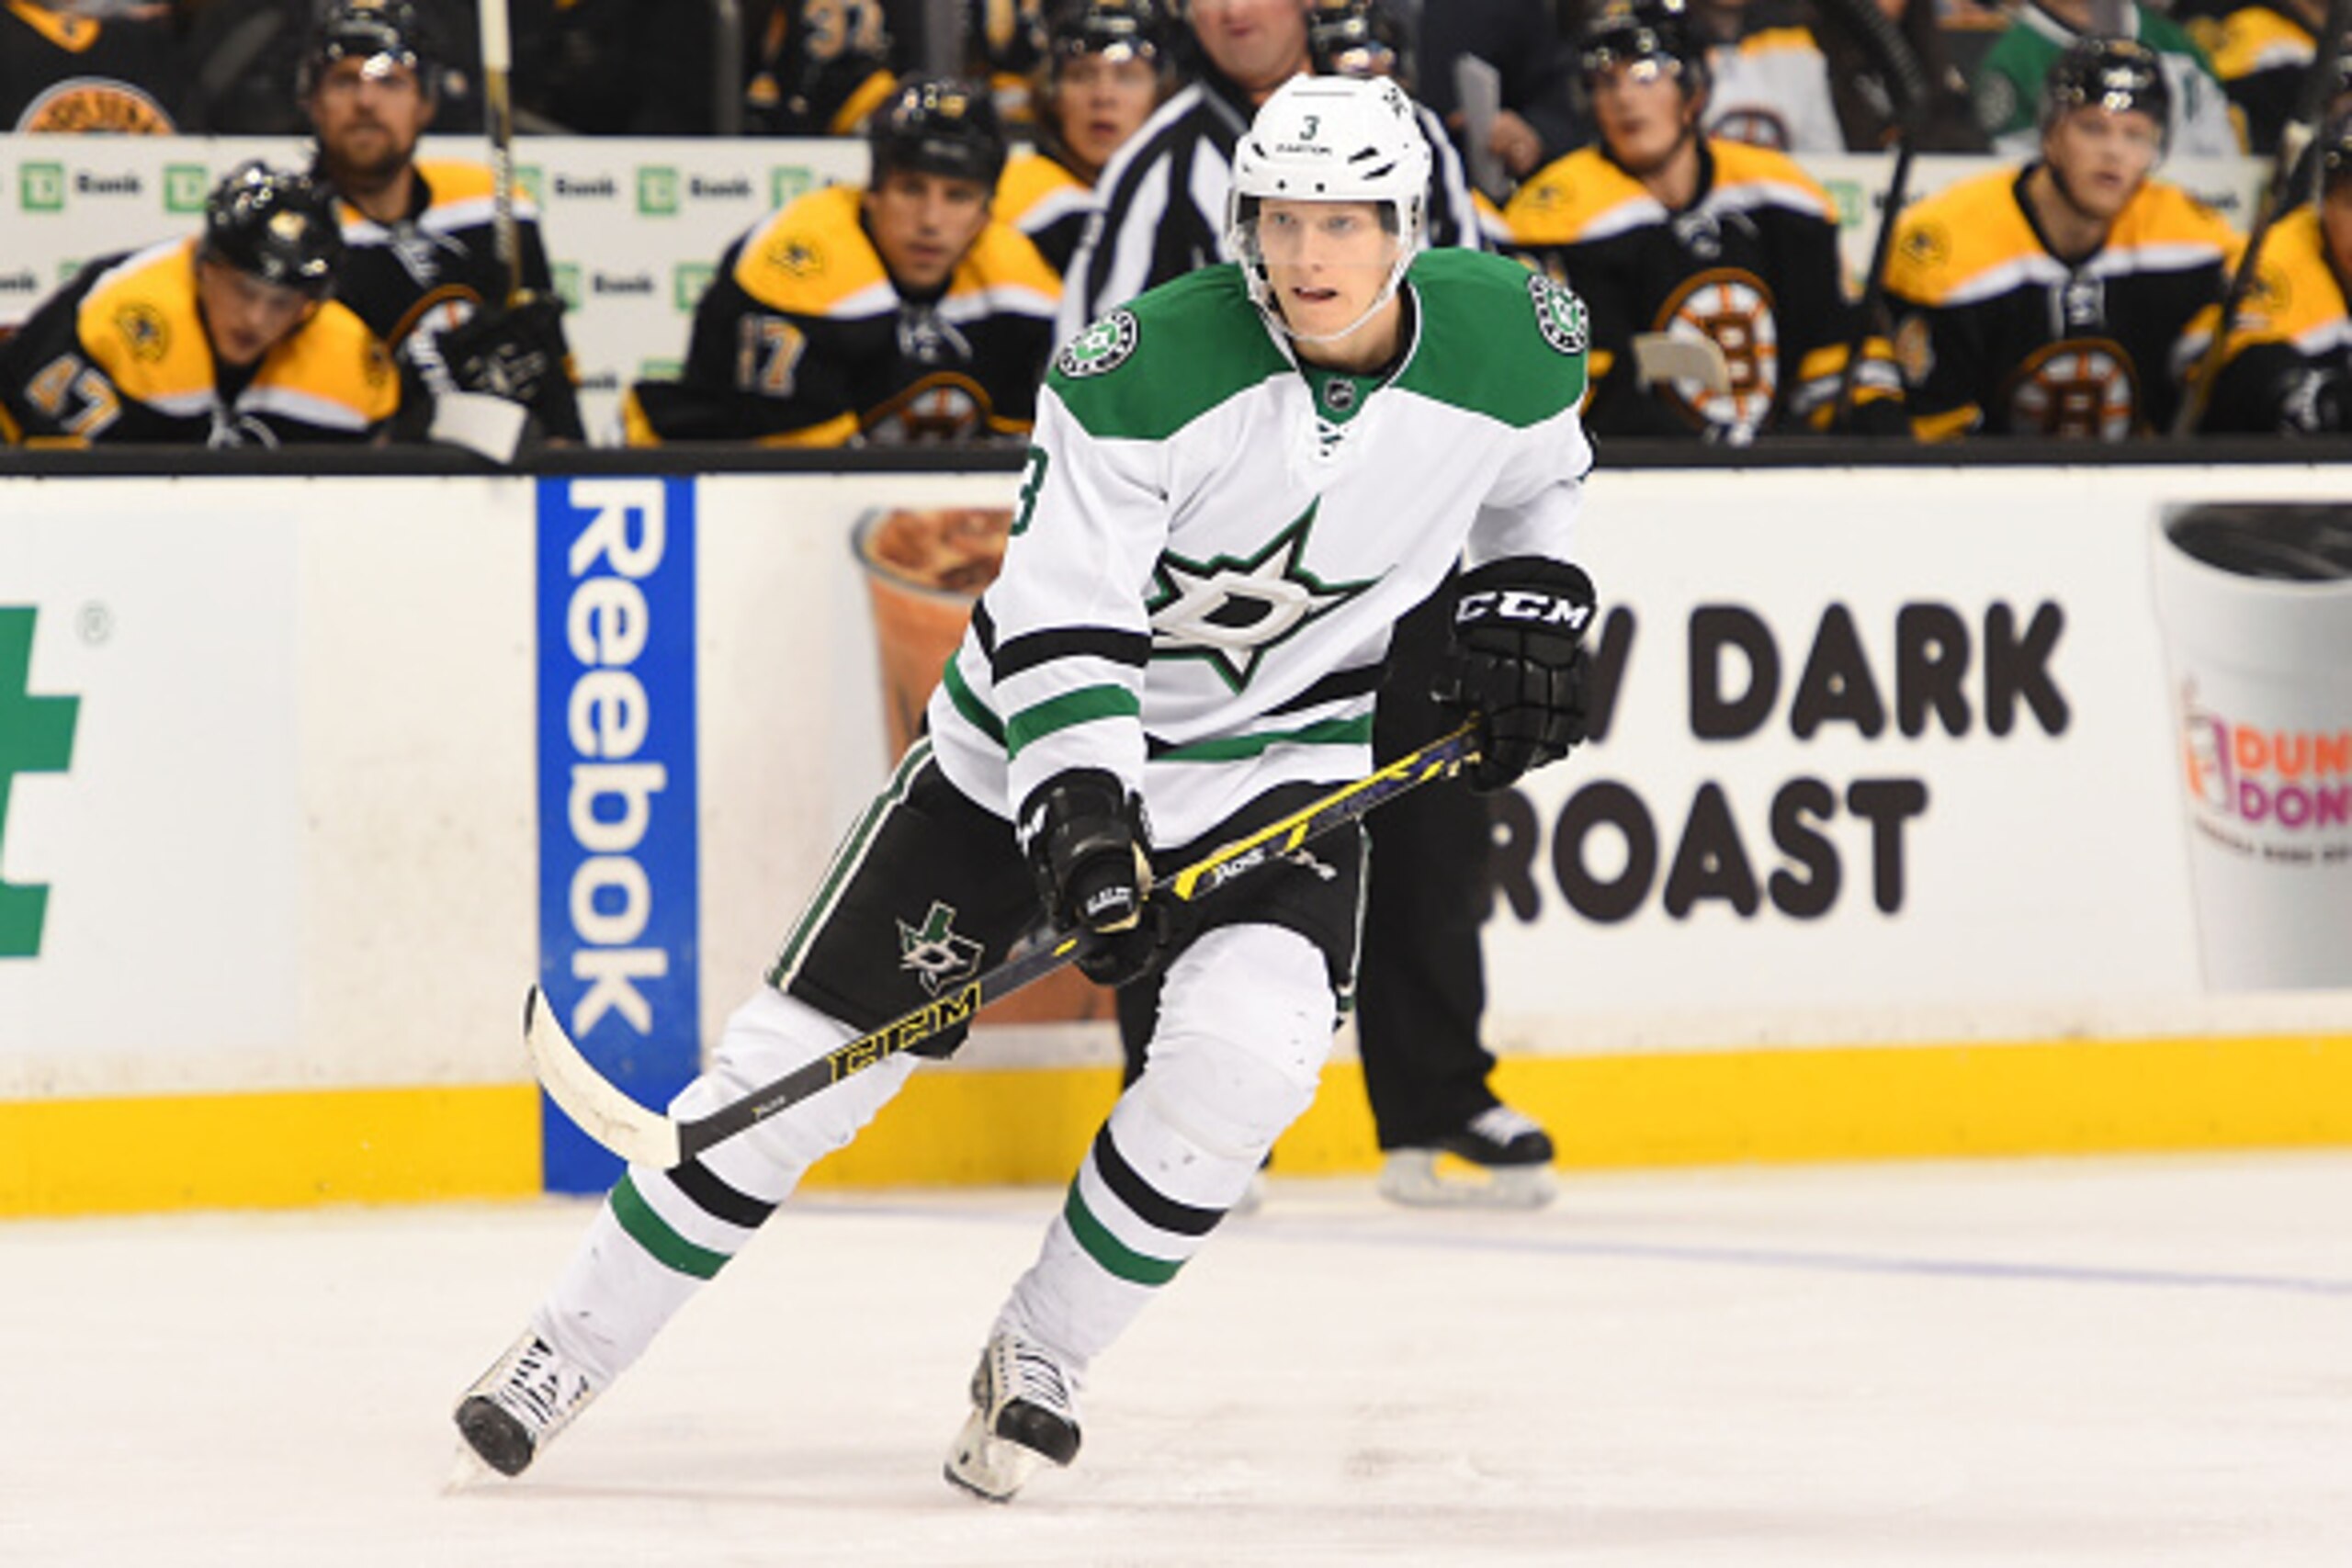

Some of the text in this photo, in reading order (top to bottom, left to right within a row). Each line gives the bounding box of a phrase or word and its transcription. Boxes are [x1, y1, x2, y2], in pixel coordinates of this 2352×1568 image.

[1298, 115, 1320, 141] 3
[24, 353, 123, 439] 47
[738, 317, 808, 397] 17
[1455, 590, 1589, 630] CCM
[1689, 602, 2072, 741] DARK
[567, 478, 668, 1039] Reebok
[1481, 777, 1928, 922] ROAST
